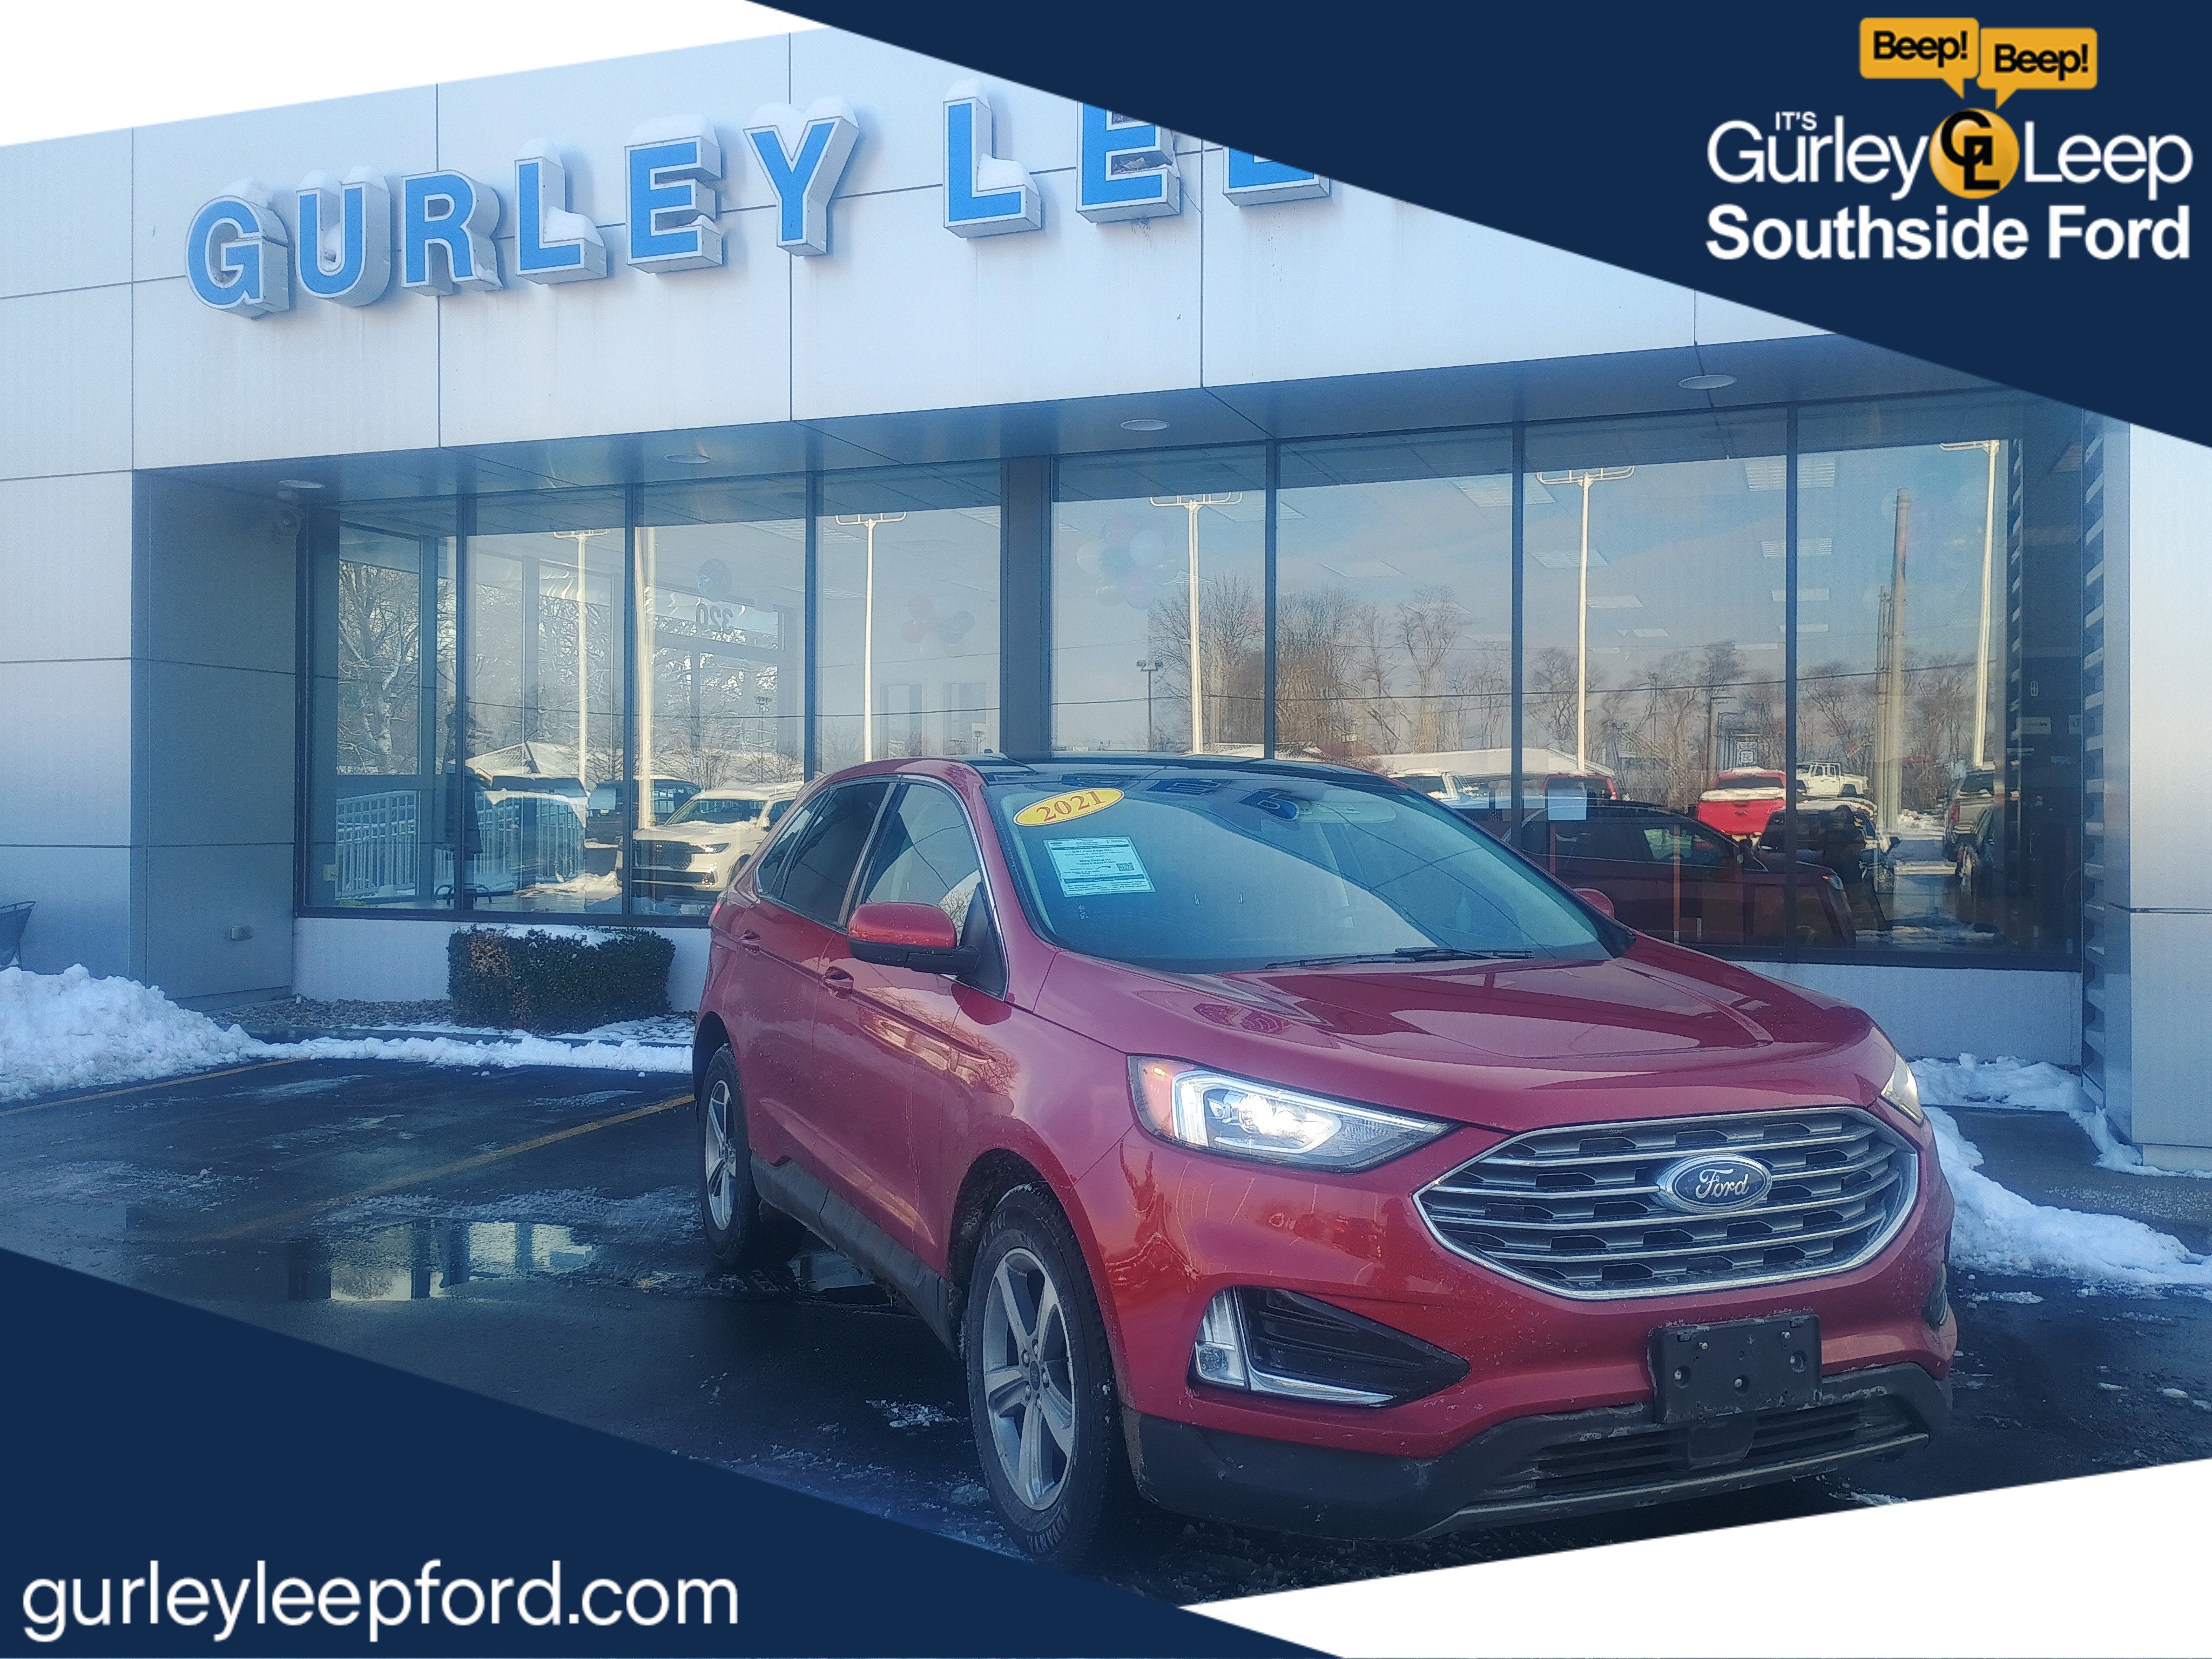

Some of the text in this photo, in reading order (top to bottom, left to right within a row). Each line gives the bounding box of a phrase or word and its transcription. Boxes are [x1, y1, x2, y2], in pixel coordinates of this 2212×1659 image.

[186, 114, 860, 320] GURLEY
[1036, 791, 1105, 822] 2021
[1695, 1168, 1750, 1199] Ford
